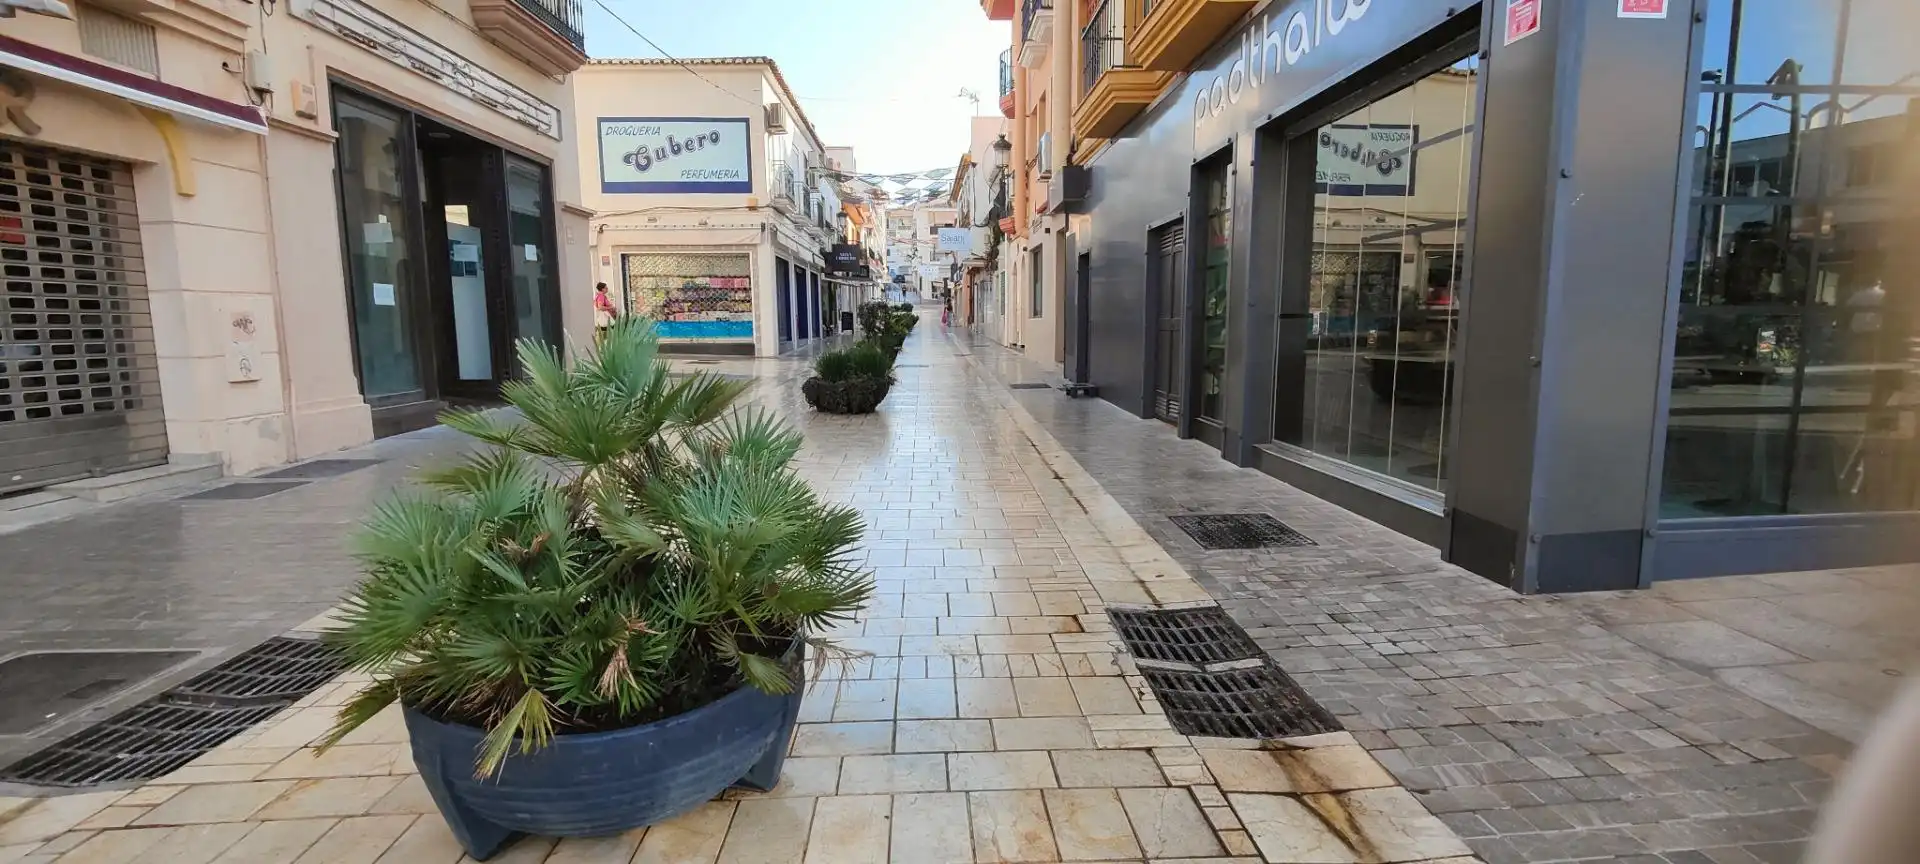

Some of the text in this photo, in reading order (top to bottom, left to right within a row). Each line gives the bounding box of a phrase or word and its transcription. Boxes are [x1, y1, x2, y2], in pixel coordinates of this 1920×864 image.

[605, 126, 661, 136] DROGUERIA
[623, 130, 721, 172] Cubero
[680, 170, 740, 180] PERFUMERIA
